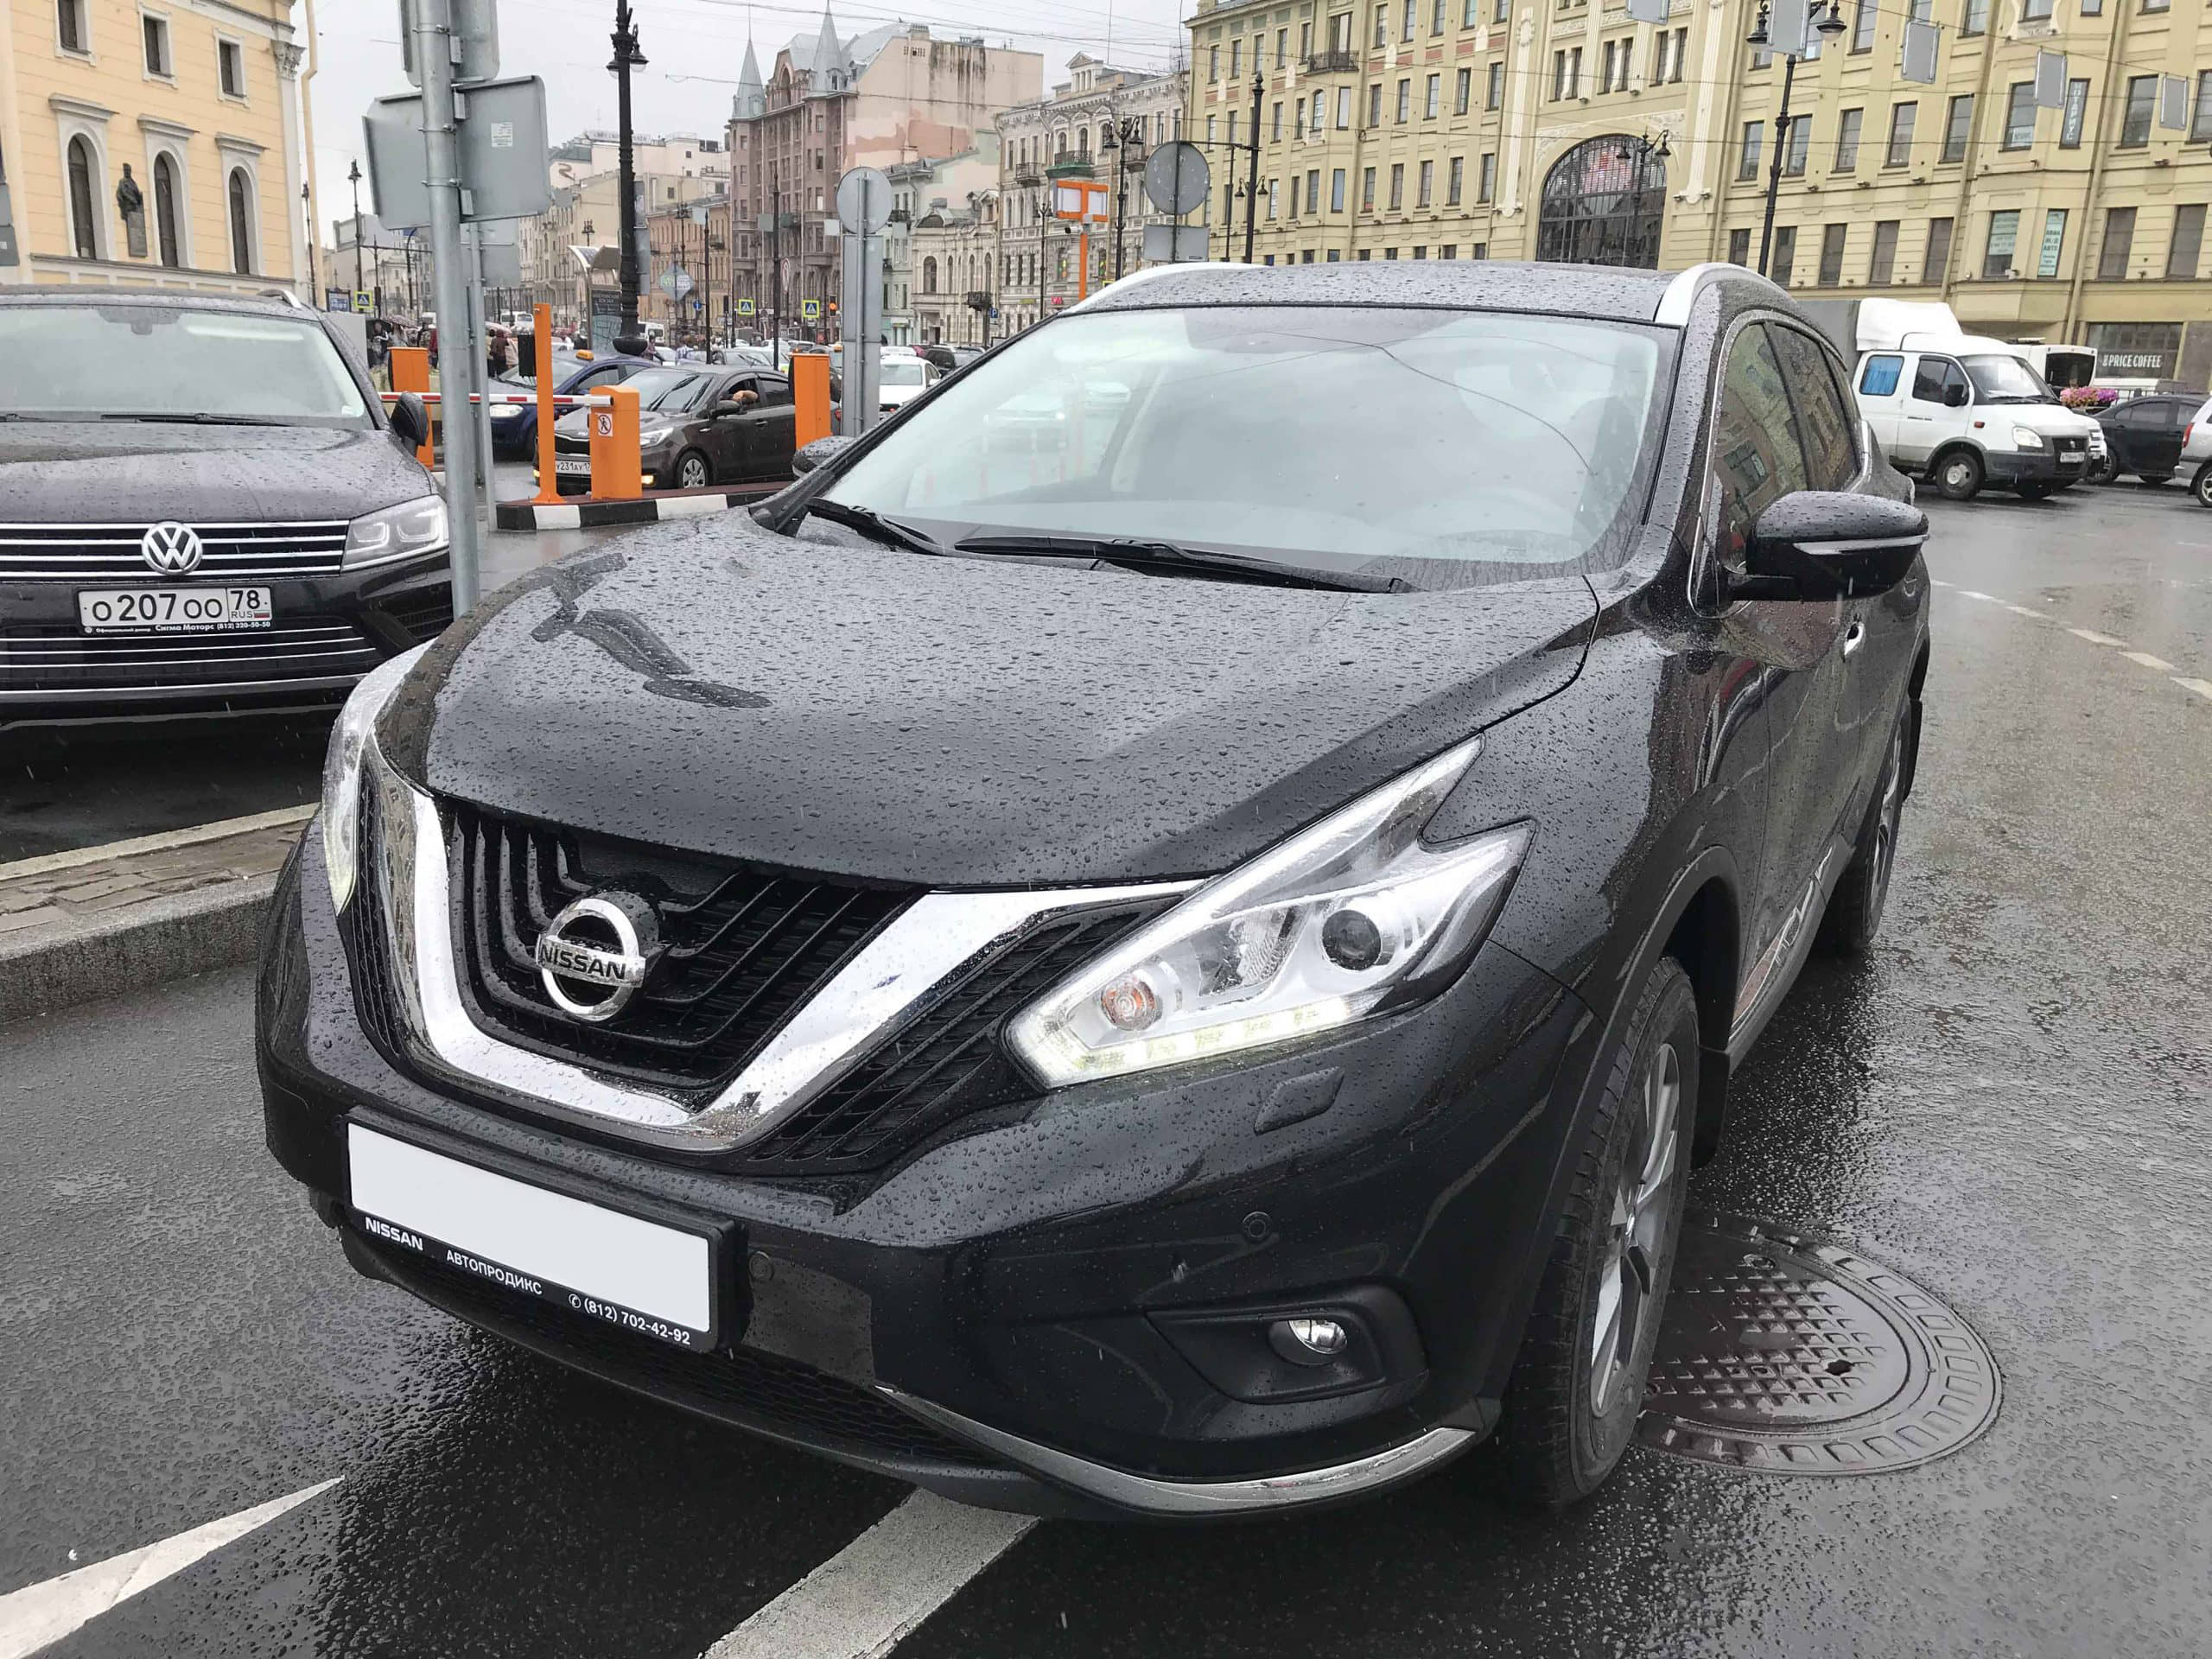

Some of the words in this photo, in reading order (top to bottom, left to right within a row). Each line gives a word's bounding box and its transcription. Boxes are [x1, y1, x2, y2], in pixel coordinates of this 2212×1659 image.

[2108, 354, 2133, 367] PRICE
[2133, 354, 2162, 368] COFFEE
[230, 590, 260, 610] 78
[231, 610, 253, 619] RUS
[541, 944, 626, 979] NISSAN
[365, 1217, 423, 1250] NISSAN
[447, 1249, 543, 1294] АВТОПРОДИКС
[584, 1298, 617, 1322] (812)
[621, 1311, 691, 1345] 702-42-92
